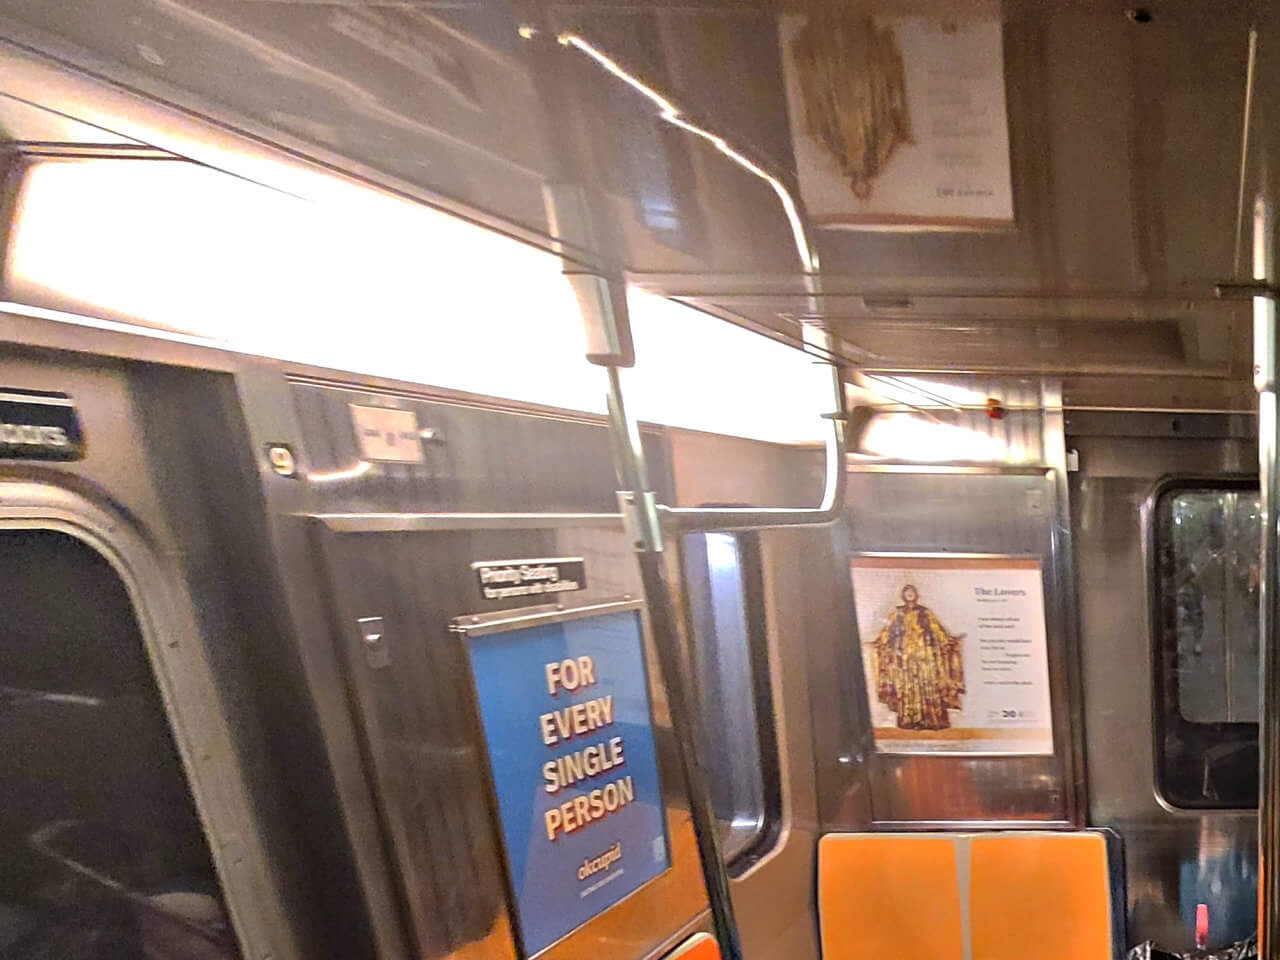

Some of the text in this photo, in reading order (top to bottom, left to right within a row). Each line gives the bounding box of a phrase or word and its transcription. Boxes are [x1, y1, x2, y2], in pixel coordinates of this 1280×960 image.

[269, 447, 295, 476] 9
[975, 587, 992, 596] The
[545, 655, 597, 696] FOR
[539, 695, 614, 746] EVERY
[543, 736, 625, 793] SINGLE
[544, 776, 635, 841] PERSON
[578, 841, 622, 881] okcupid
